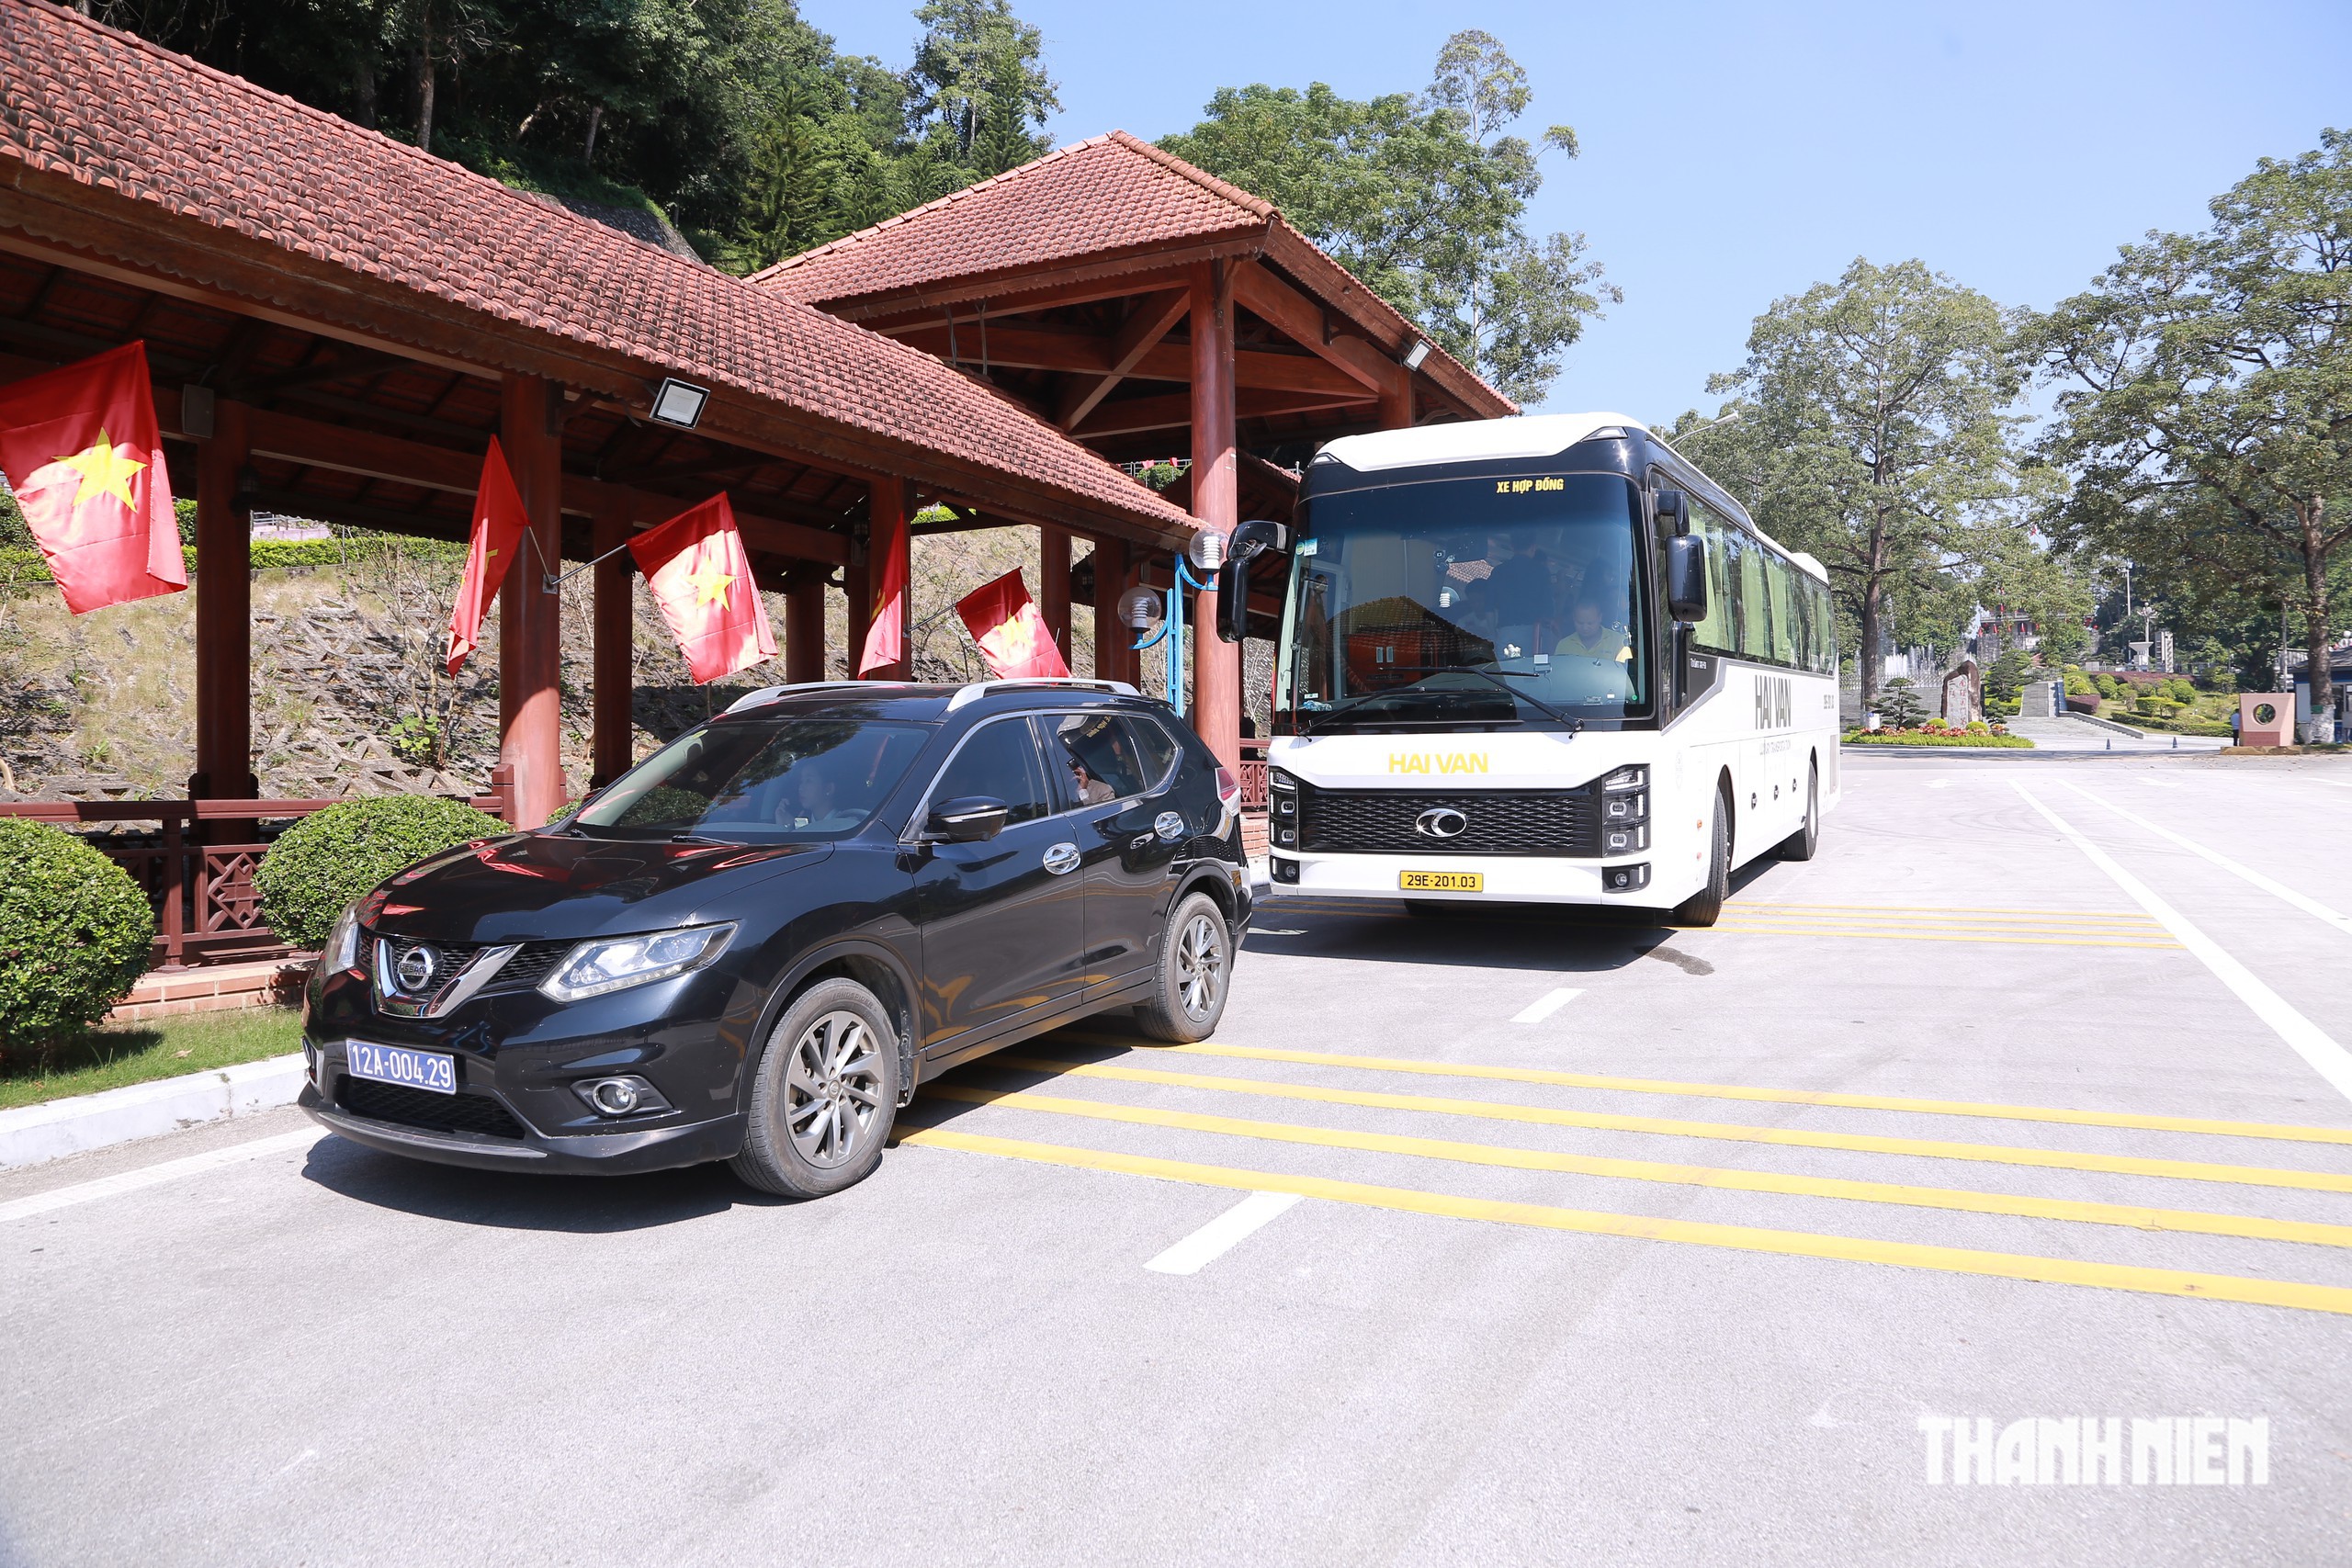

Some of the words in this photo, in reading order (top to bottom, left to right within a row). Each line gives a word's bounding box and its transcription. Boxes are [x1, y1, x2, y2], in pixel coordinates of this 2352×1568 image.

[1497, 481, 1510, 493] XE
[1512, 479, 1533, 494] HỢP
[1535, 476, 1565, 491] ĐỒNG
[1755, 674, 1771, 730] HAI
[1773, 677, 1792, 728] VAN
[1388, 752, 1430, 774] HAI
[1434, 752, 1488, 774] VAN
[1407, 874, 1476, 888] 29E-201.03
[352, 1044, 452, 1089] 12A-004.29
